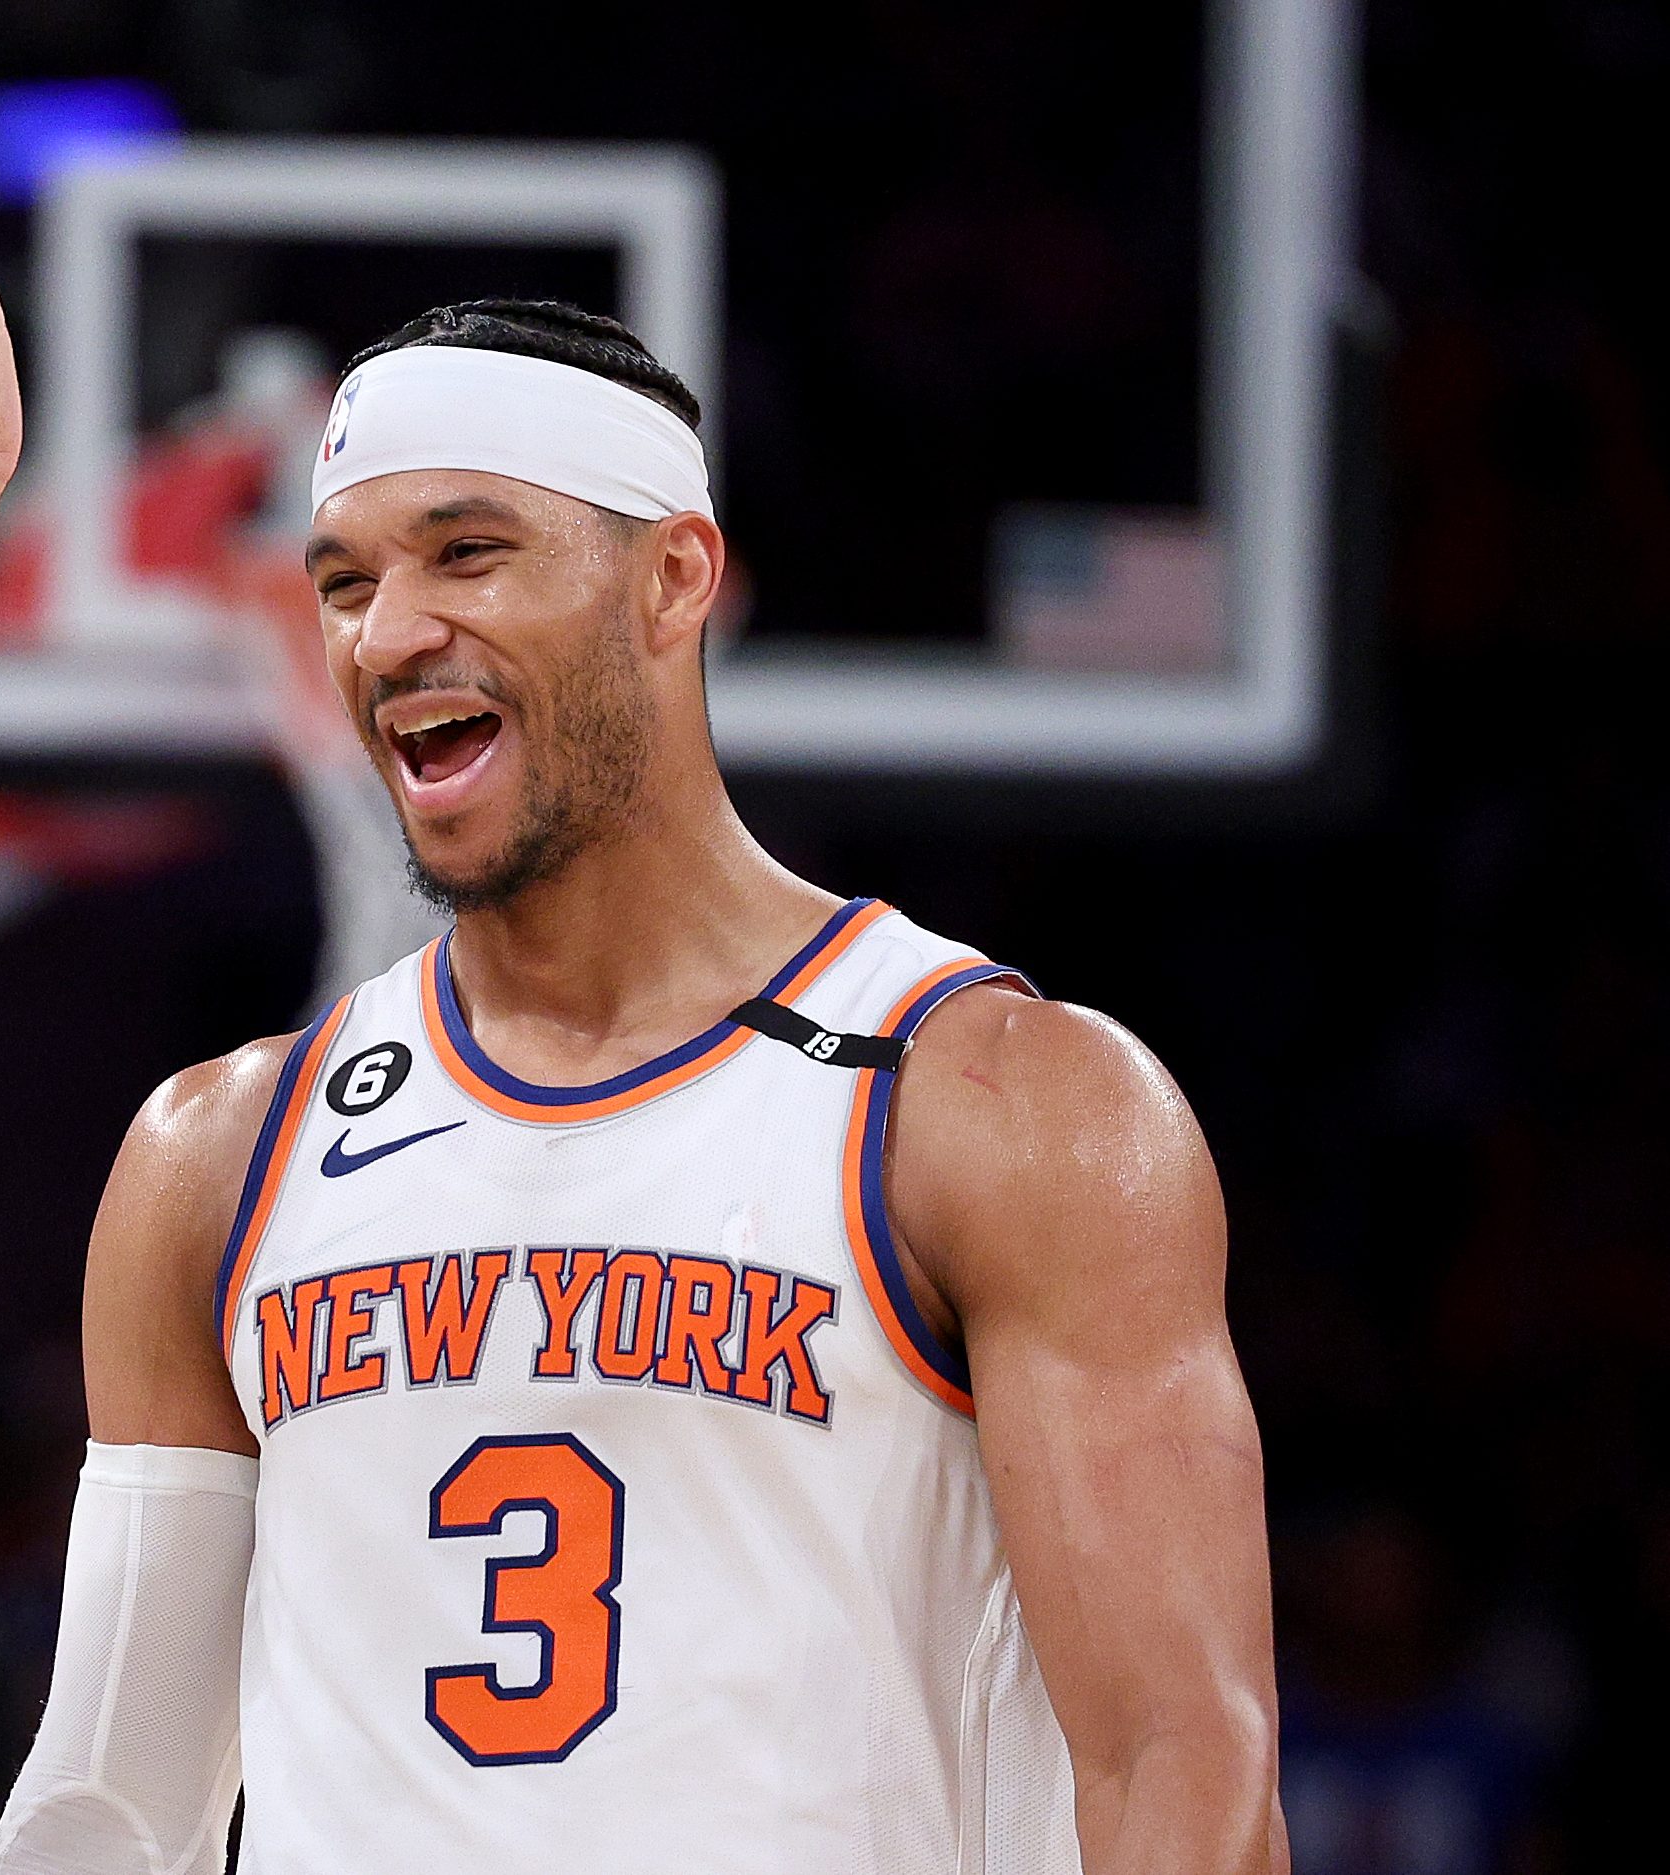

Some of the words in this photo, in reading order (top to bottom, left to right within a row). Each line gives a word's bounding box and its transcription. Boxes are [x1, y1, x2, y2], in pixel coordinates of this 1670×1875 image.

[341, 1050, 396, 1107] 6
[802, 1031, 841, 1060] 19
[255, 1244, 517, 1437] NEW
[524, 1243, 842, 1431] YORK
[425, 1432, 626, 1767] 3
